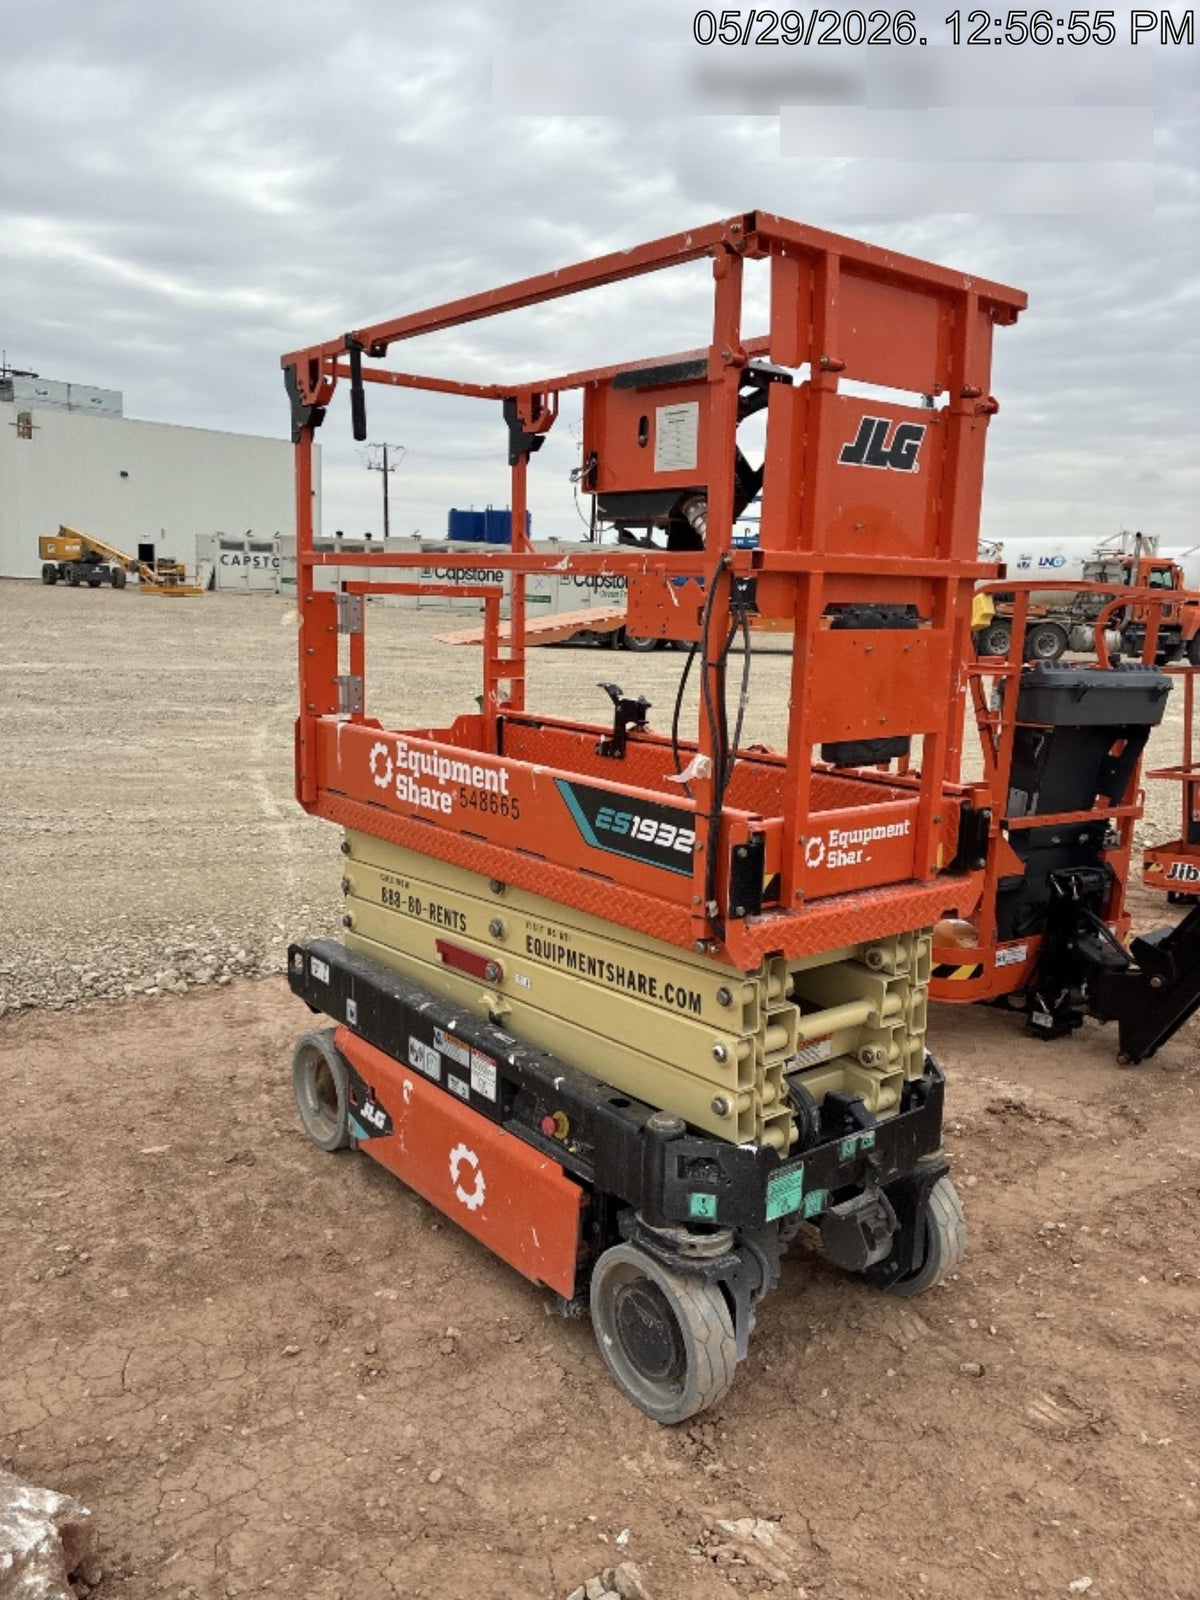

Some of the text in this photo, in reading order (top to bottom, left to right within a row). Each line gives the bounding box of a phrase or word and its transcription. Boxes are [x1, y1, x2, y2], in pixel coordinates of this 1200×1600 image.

[837, 415, 926, 473] JLG
[396, 741, 509, 795] Equipment
[396, 773, 452, 814] Share
[460, 787, 520, 820] 548665
[595, 806, 695, 854] ES1932
[828, 819, 911, 848] Equipment
[826, 849, 873, 868] Shar
[526, 935, 702, 1015] EQUIPMENTSHARE.COM
